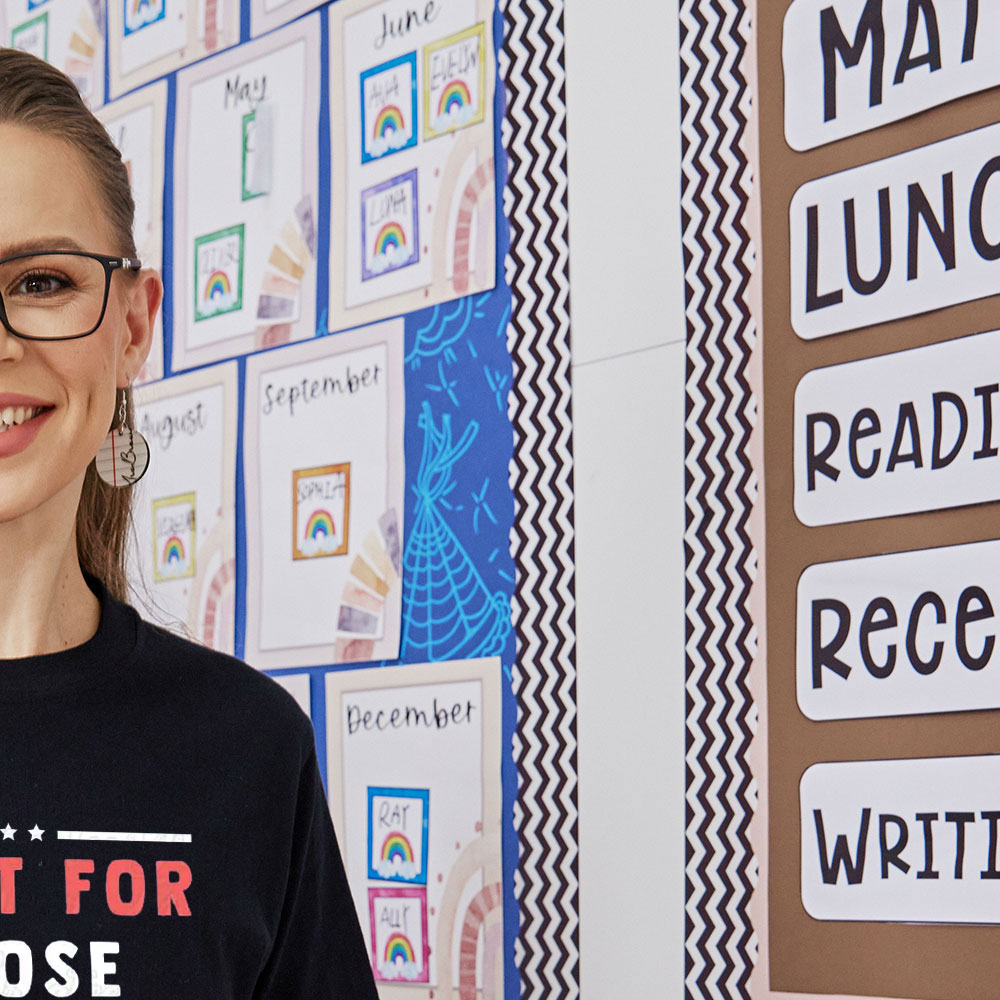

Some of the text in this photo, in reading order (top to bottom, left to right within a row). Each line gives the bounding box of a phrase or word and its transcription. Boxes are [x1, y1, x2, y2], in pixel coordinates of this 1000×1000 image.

[374, 0, 441, 50] June
[224, 75, 267, 110] May
[263, 364, 382, 416] September
[140, 402, 208, 451] August
[346, 698, 477, 734] December
[812, 807, 1000, 885] WRITI
[64, 858, 193, 917] FOR
